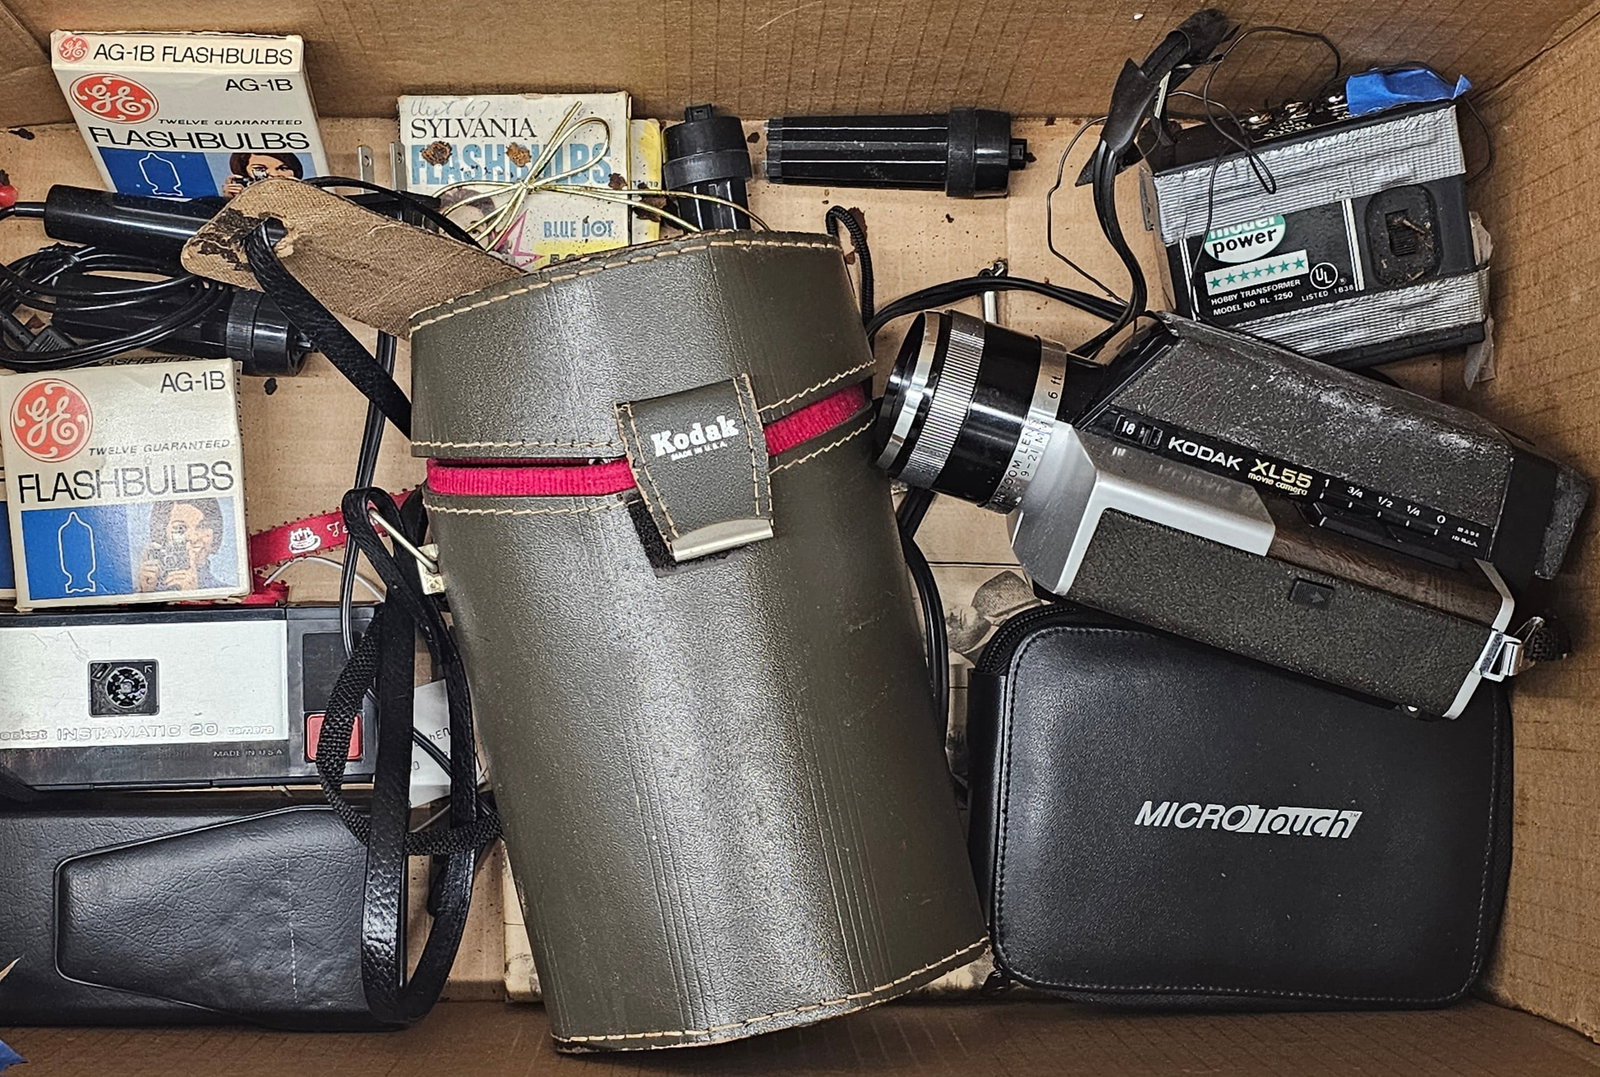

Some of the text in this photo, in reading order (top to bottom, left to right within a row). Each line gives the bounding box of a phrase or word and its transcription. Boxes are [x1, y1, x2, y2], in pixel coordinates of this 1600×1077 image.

[93, 43, 293, 65] AG-1B FLASHBULBS
[225, 78, 293, 92] AG-1B
[159, 118, 209, 126] TWELVE
[411, 117, 537, 139] SYLVANIA
[88, 126, 310, 150] FLASHBULBS
[543, 220, 614, 239] BLUE DOT
[1212, 228, 1277, 260] power
[1210, 279, 1301, 306] HOBBY TRANSFORMER
[1301, 290, 1329, 302] LISTED
[1212, 304, 1243, 316] MODEL
[1273, 291, 1294, 301] 1250
[160, 370, 226, 393] AG-1B
[1047, 391, 1059, 400] 6
[650, 415, 739, 457] Kodak
[1121, 420, 1136, 435] 18
[89, 439, 230, 456] TWELVE GUARANTEED
[1168, 436, 1313, 489] KODAK XL55
[18, 460, 234, 504] FLASHBULBS
[1247, 472, 1308, 496] movie camera
[1347, 486, 1364, 499] 3/4
[1378, 496, 1394, 509] 1/2
[1406, 504, 1421, 517] 1/4
[0, 729, 48, 741] ocket
[56, 724, 182, 741] INSTAMATIC
[188, 722, 219, 736] 20
